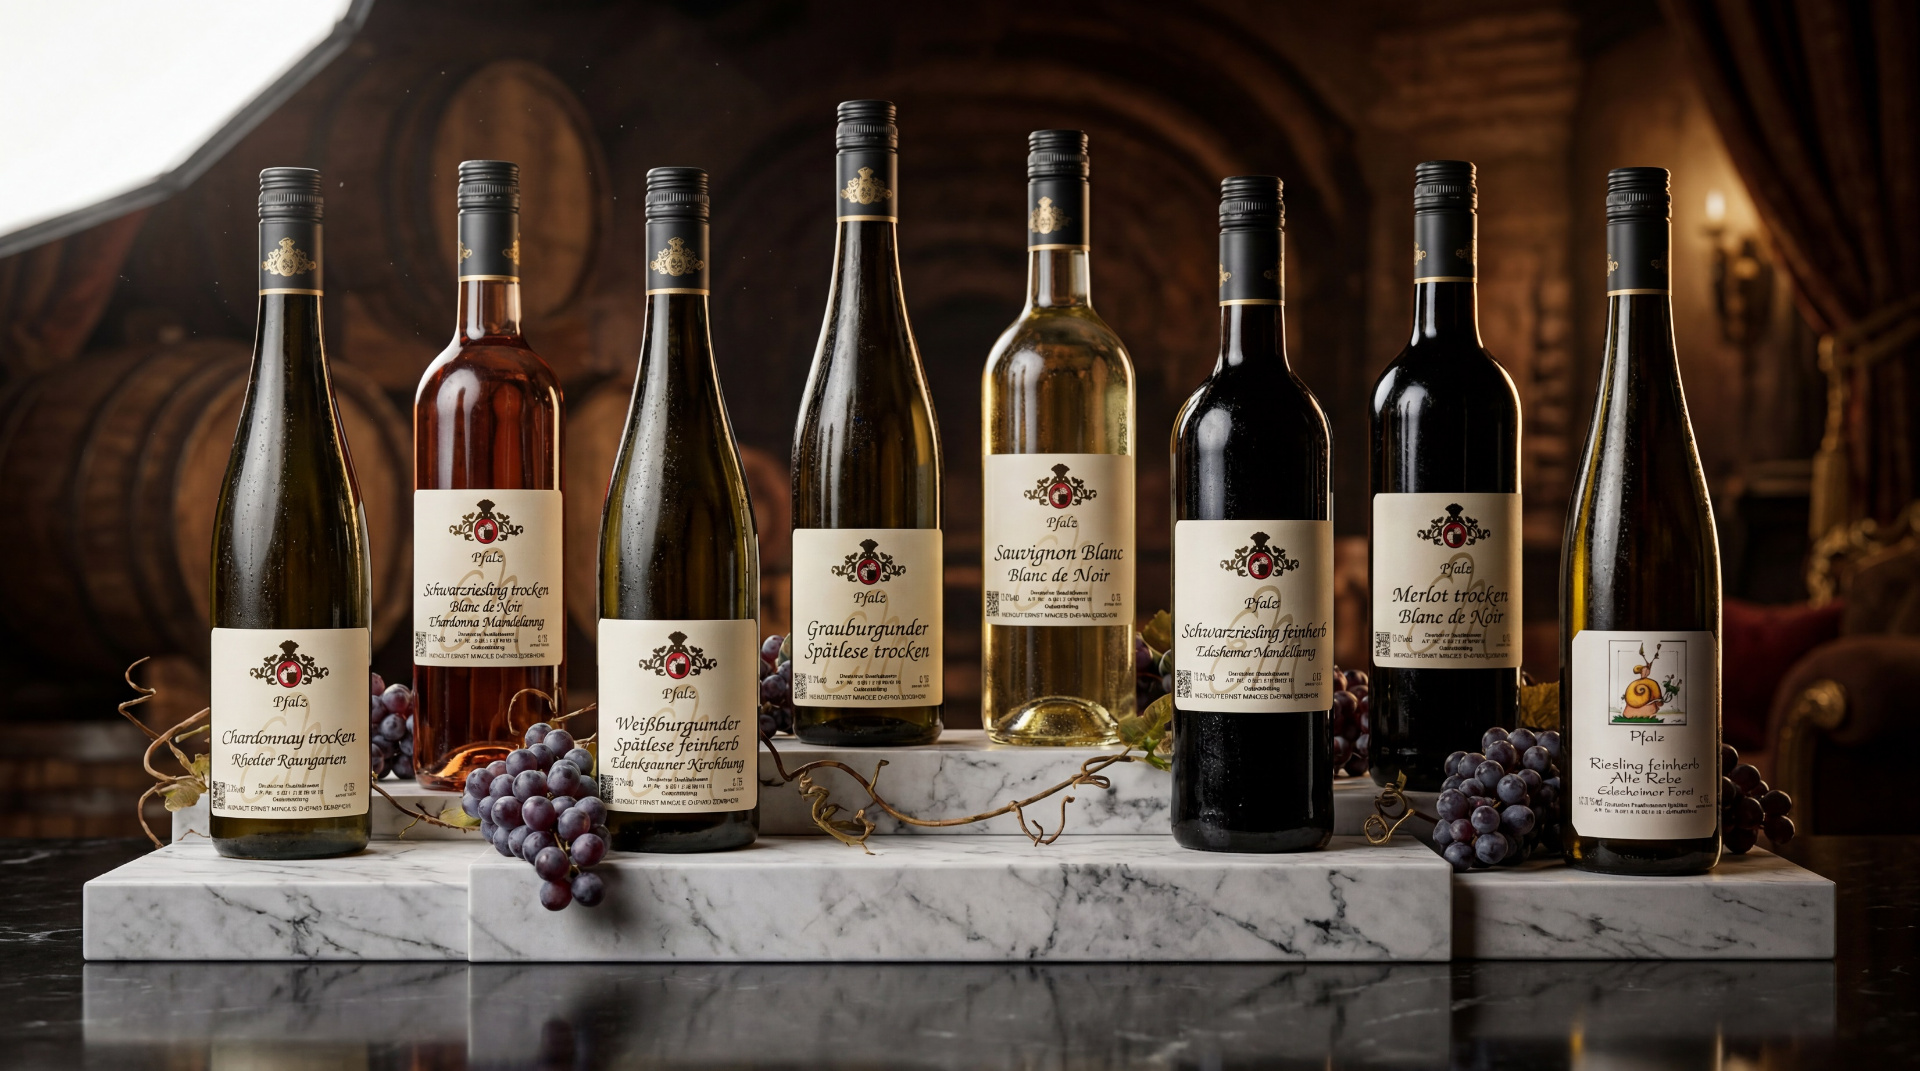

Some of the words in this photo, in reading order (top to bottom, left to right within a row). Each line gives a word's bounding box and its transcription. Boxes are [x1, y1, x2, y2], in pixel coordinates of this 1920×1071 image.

[1046, 516, 1078, 532] Pfalz
[472, 551, 503, 567] Pfalz
[994, 544, 1077, 566] Sauvignon
[1081, 543, 1123, 560] Blanc
[1008, 566, 1047, 582] Blanc
[1052, 566, 1068, 582] de
[1072, 566, 1110, 582] Noir
[423, 582, 508, 600] Schwarzriesling
[511, 582, 549, 598] trocken
[854, 590, 886, 607] Pfalz
[1392, 585, 1448, 602] Merlot
[1454, 586, 1508, 606] trocken
[450, 600, 479, 613] Blanc
[482, 600, 495, 612] de
[497, 600, 523, 614] Noir
[1244, 596, 1280, 612] Pfalz
[1398, 608, 1443, 624] Blanc
[1448, 608, 1466, 624] de
[1470, 608, 1504, 627] Noir
[807, 618, 929, 642] Grauburgunder
[1182, 622, 1278, 643] Schwarzriesling
[1279, 622, 1326, 642] feinherb
[804, 640, 868, 664] Spätlese
[874, 640, 930, 661] trocken
[273, 695, 308, 711] Pfalz
[662, 686, 697, 703] Pfalz
[615, 715, 741, 737] Weißburgunder
[222, 729, 305, 750] Chardonnay
[309, 728, 356, 746] trocken
[614, 737, 674, 756] Spätlese
[675, 735, 739, 757] feinherb
[1630, 730, 1664, 746] Pfalz
[1590, 757, 1643, 774] Riesling
[1648, 758, 1700, 773] feinherb
[1610, 772, 1640, 784] Alte
[1645, 772, 1682, 784] Rebe
